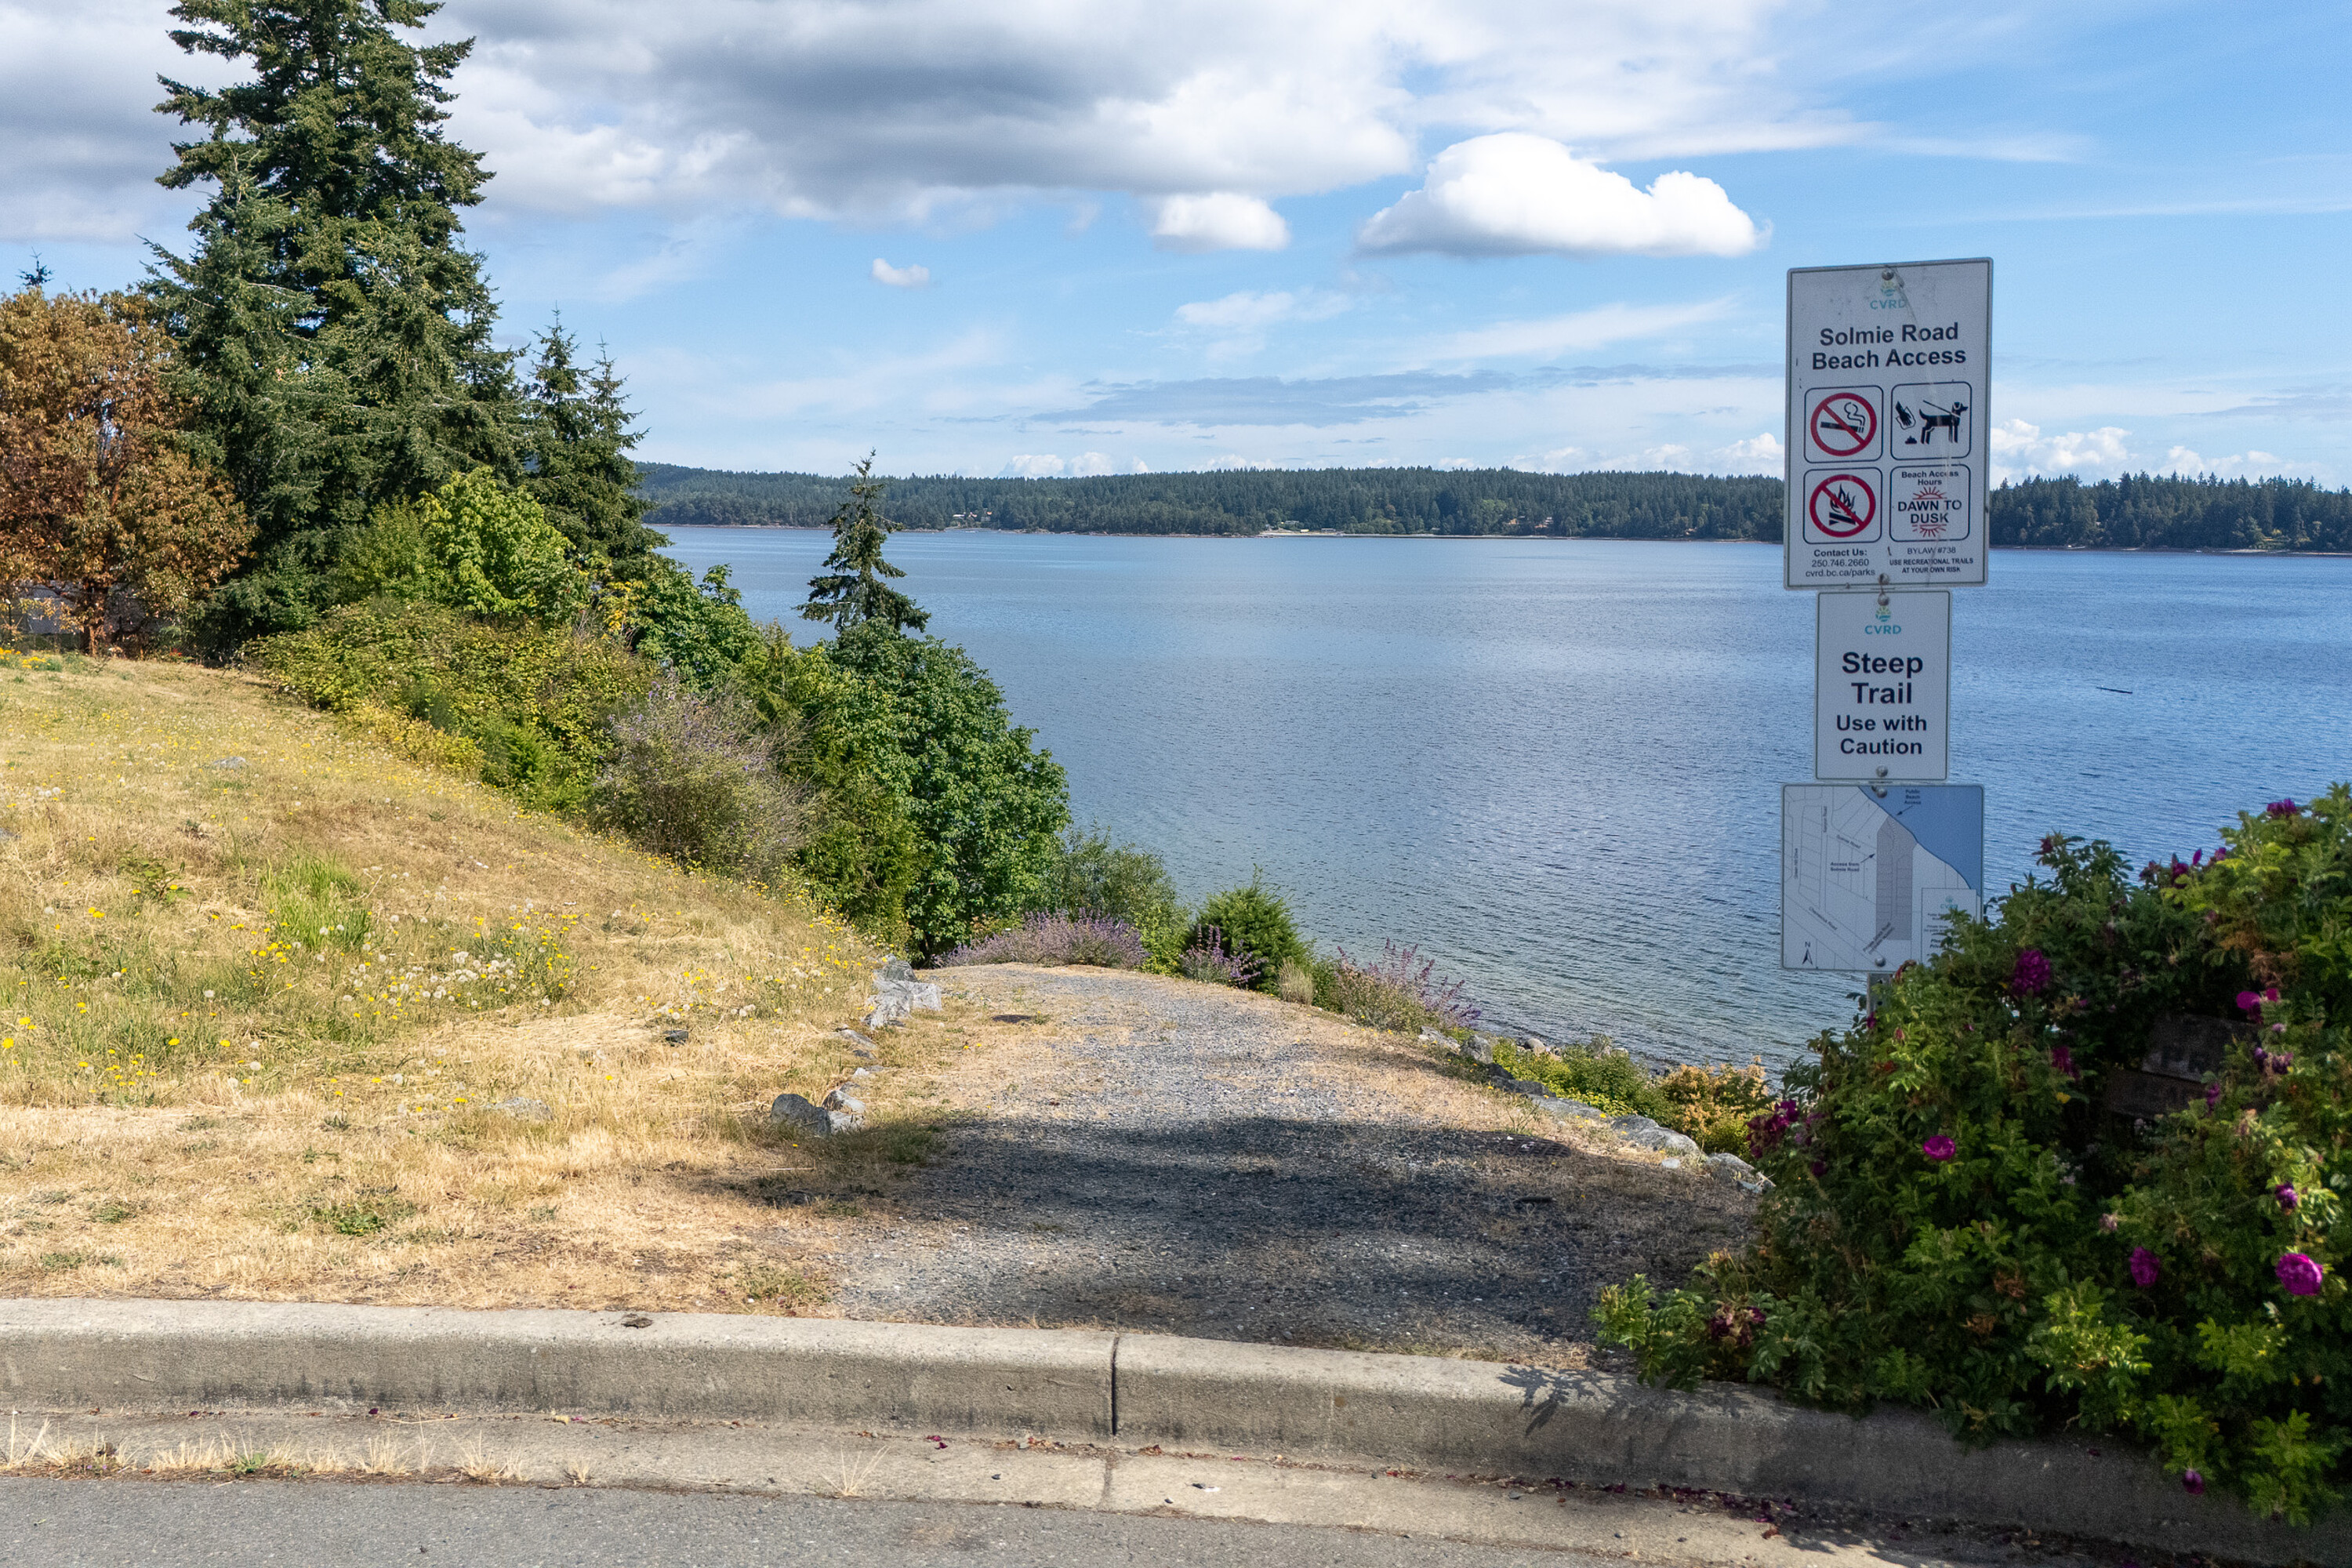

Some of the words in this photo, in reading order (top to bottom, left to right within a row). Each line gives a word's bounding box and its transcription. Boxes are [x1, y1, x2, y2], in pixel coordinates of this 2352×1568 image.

[1870, 299, 1907, 310] CVRD
[1820, 326, 1894, 346] Solmie
[1902, 322, 1958, 342] Road
[1812, 350, 1878, 369] Beach
[1886, 349, 1966, 367] Access
[1897, 500, 1939, 511] DAWN
[1944, 499, 1962, 510] TO
[1911, 513, 1949, 524] DUSK
[1811, 558, 1870, 568] 250.746.2660
[1806, 568, 1875, 577] cvrd.bc.ca/parks
[1864, 625, 1902, 634] CVRD
[1842, 652, 1923, 679] Steep
[1851, 682, 1912, 703] Trail
[1836, 714, 1876, 731] Use
[1882, 715, 1927, 731] with
[1840, 738, 1922, 754] Caution
